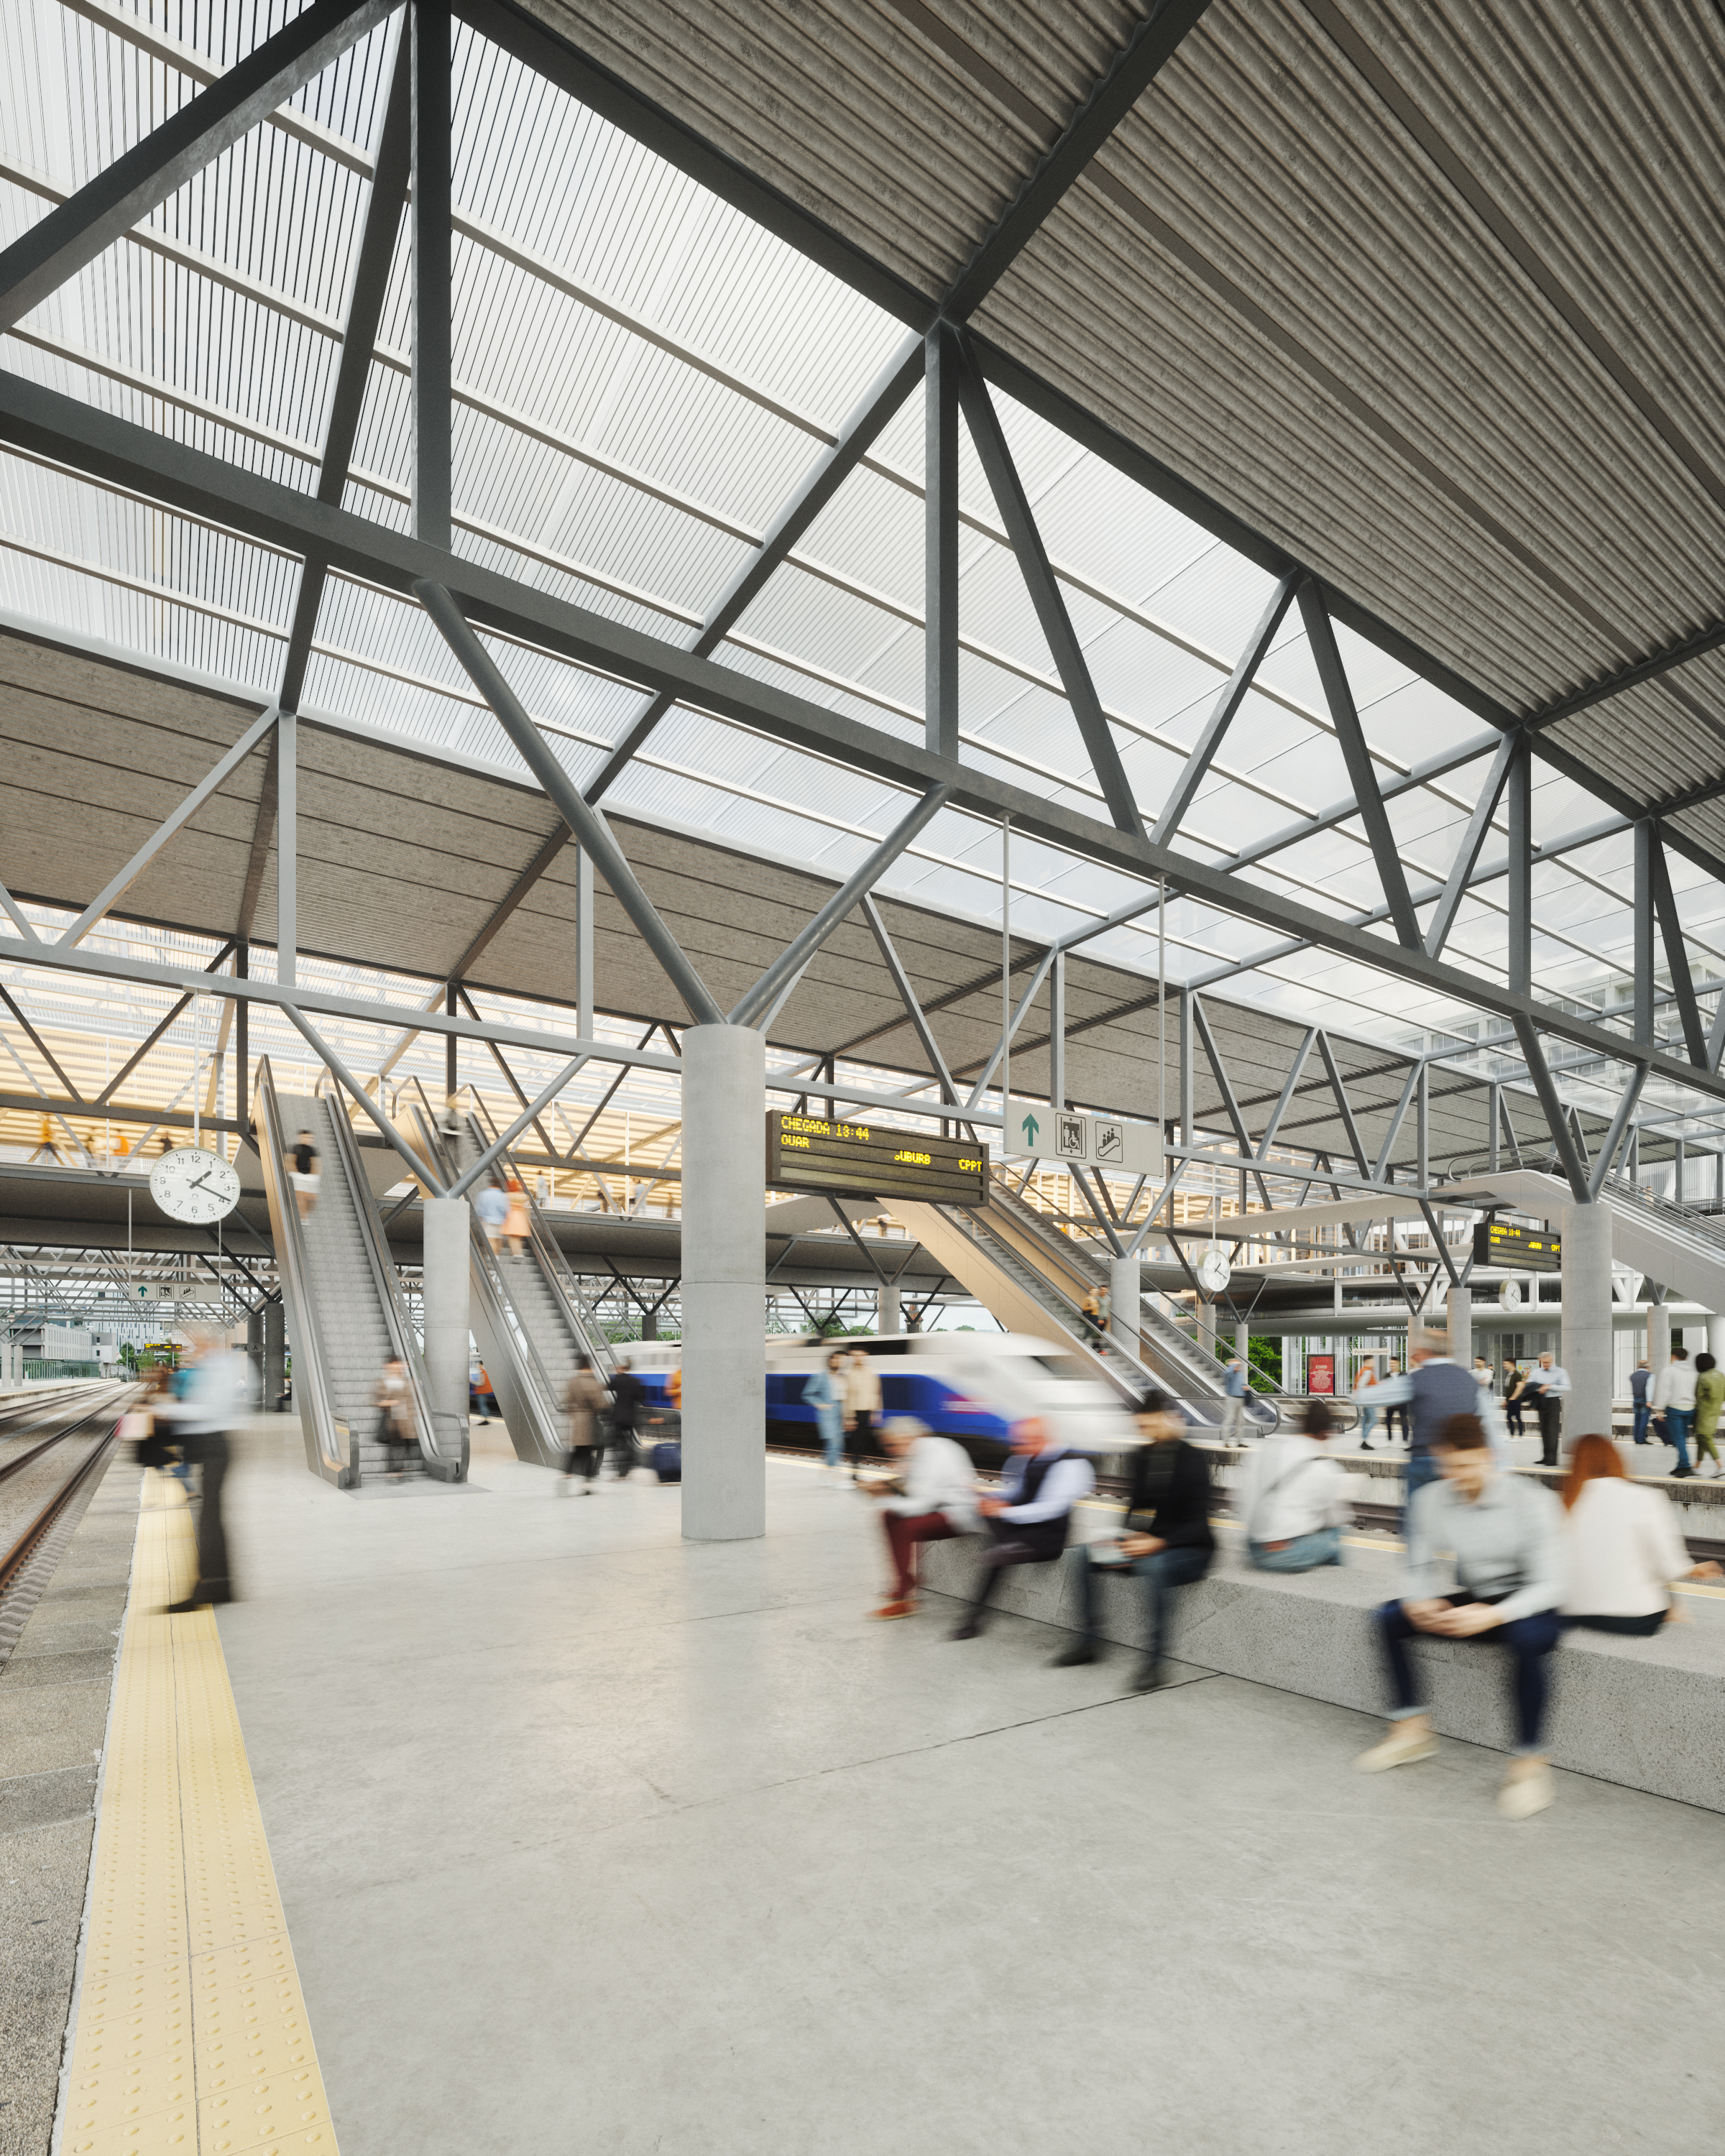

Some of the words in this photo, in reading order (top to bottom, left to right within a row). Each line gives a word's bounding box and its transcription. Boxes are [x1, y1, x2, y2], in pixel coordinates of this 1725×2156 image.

[781, 1115, 830, 1135] CHEGADA
[958, 1158, 982, 1171] CPPT
[208, 1203, 214, 1212] 5
